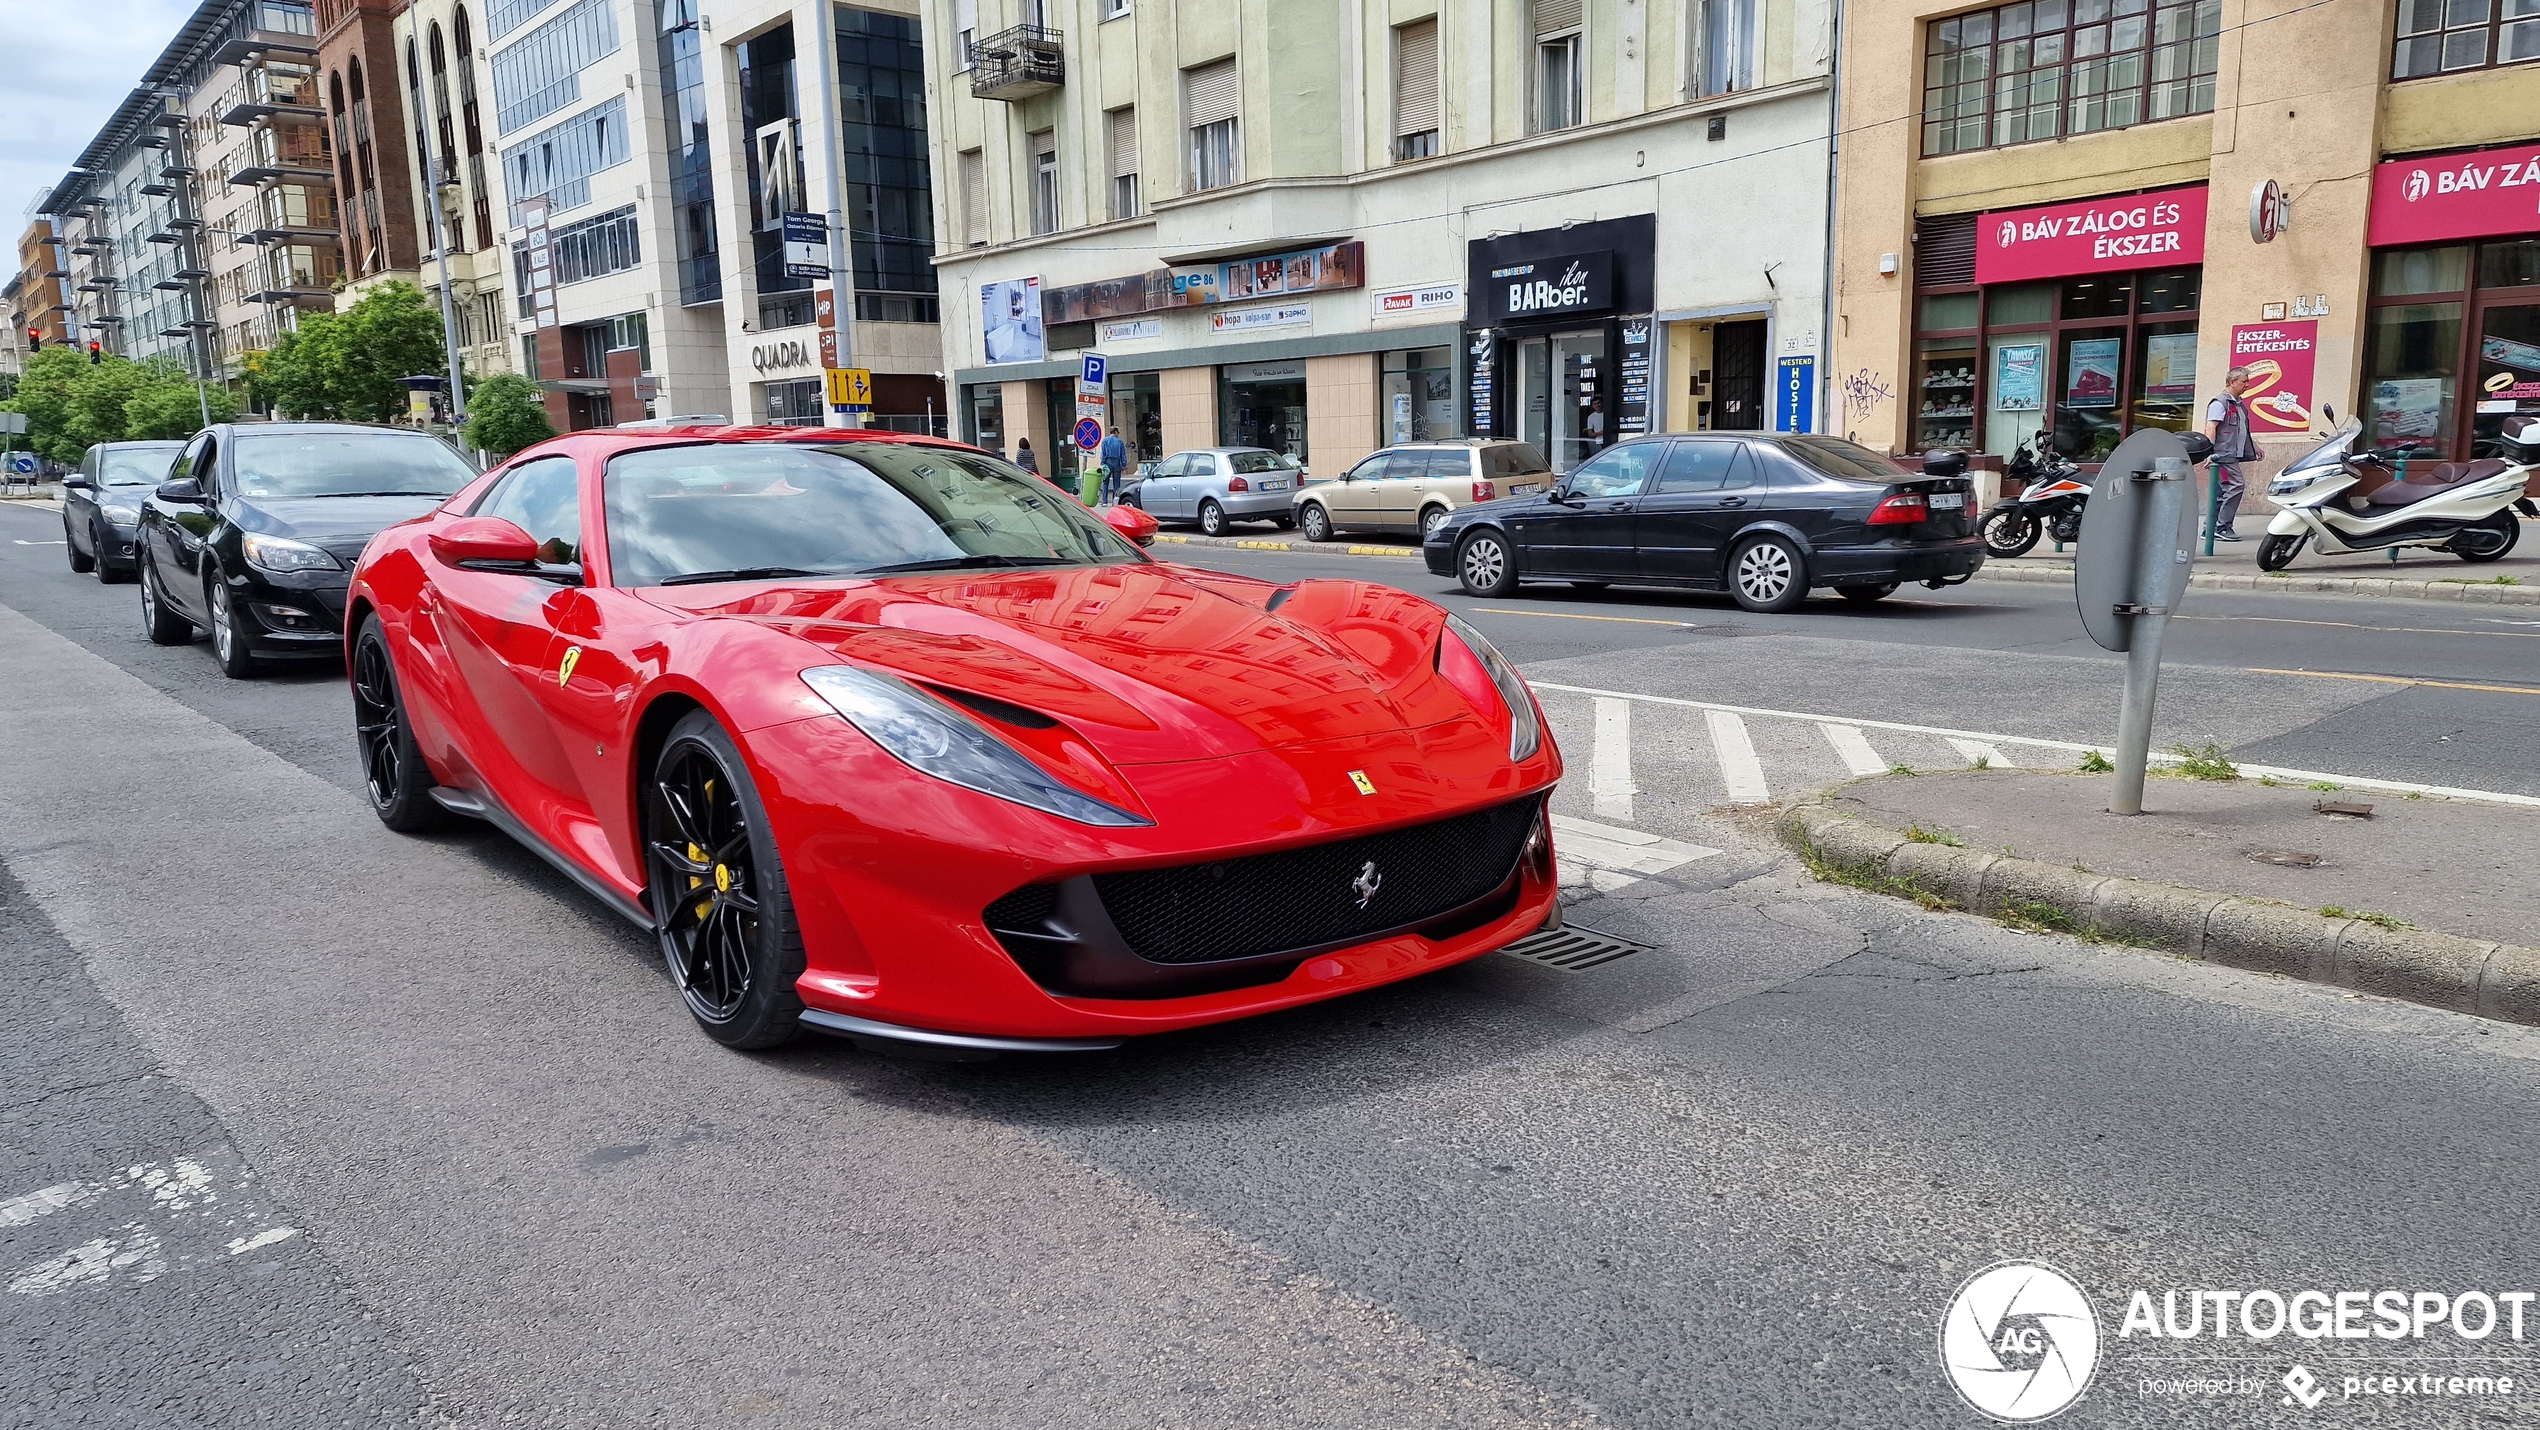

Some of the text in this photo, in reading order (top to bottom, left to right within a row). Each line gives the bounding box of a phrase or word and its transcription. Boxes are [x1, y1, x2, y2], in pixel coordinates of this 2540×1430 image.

[2437, 163, 2495, 194] BÁV
[802, 216, 824, 225] George
[2022, 200, 2180, 241] BÁV ZÁLOG ÉS
[2094, 231, 2180, 259] ÉKSZER
[1203, 273, 1214, 286] 86
[1559, 260, 1589, 287] ikon
[1421, 290, 1454, 302] RIHO
[1385, 298, 1411, 309] RAVAK
[1224, 312, 1241, 326] hopa
[2237, 329, 2286, 342] ÉKSZER-
[1787, 341, 1795, 349] 32
[2236, 338, 2310, 354] ÉRTÉKESÍTÉS
[752, 339, 811, 377] QUADRA
[1780, 358, 1812, 366] WESTEND
[1088, 360, 1101, 378] P
